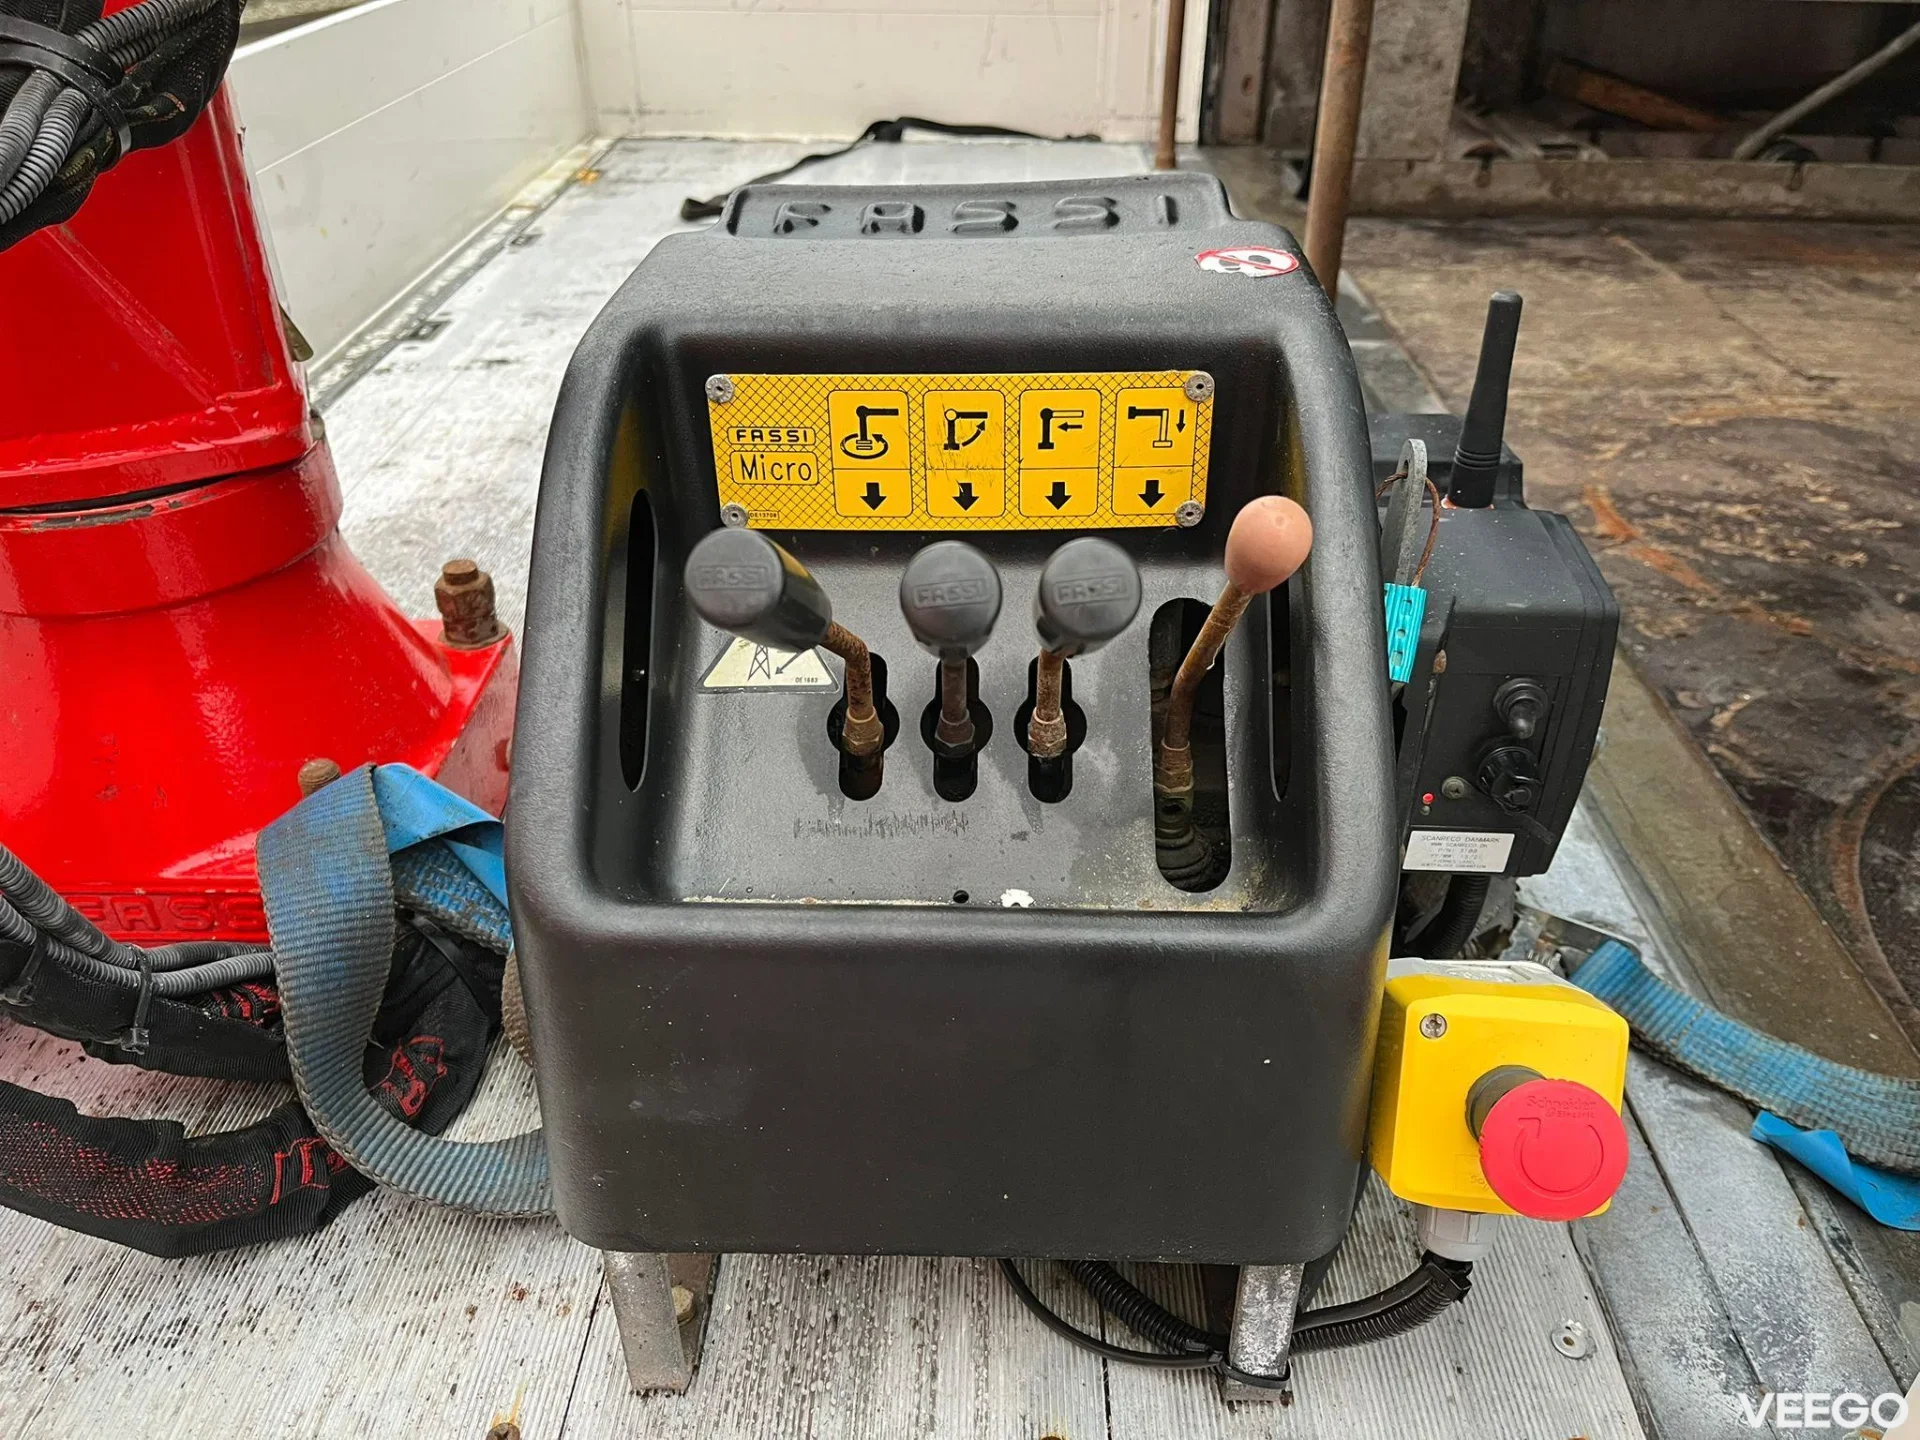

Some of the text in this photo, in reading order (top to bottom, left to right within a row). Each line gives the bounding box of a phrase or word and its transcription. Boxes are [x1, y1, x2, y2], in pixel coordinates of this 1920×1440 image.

[773, 195, 1178, 234] FASSI
[736, 429, 808, 442] FASSI
[740, 453, 812, 481] Micro
[917, 580, 984, 604] FASSI
[1057, 576, 1127, 602] FASSI
[1527, 1095, 1596, 1110] Schneider
